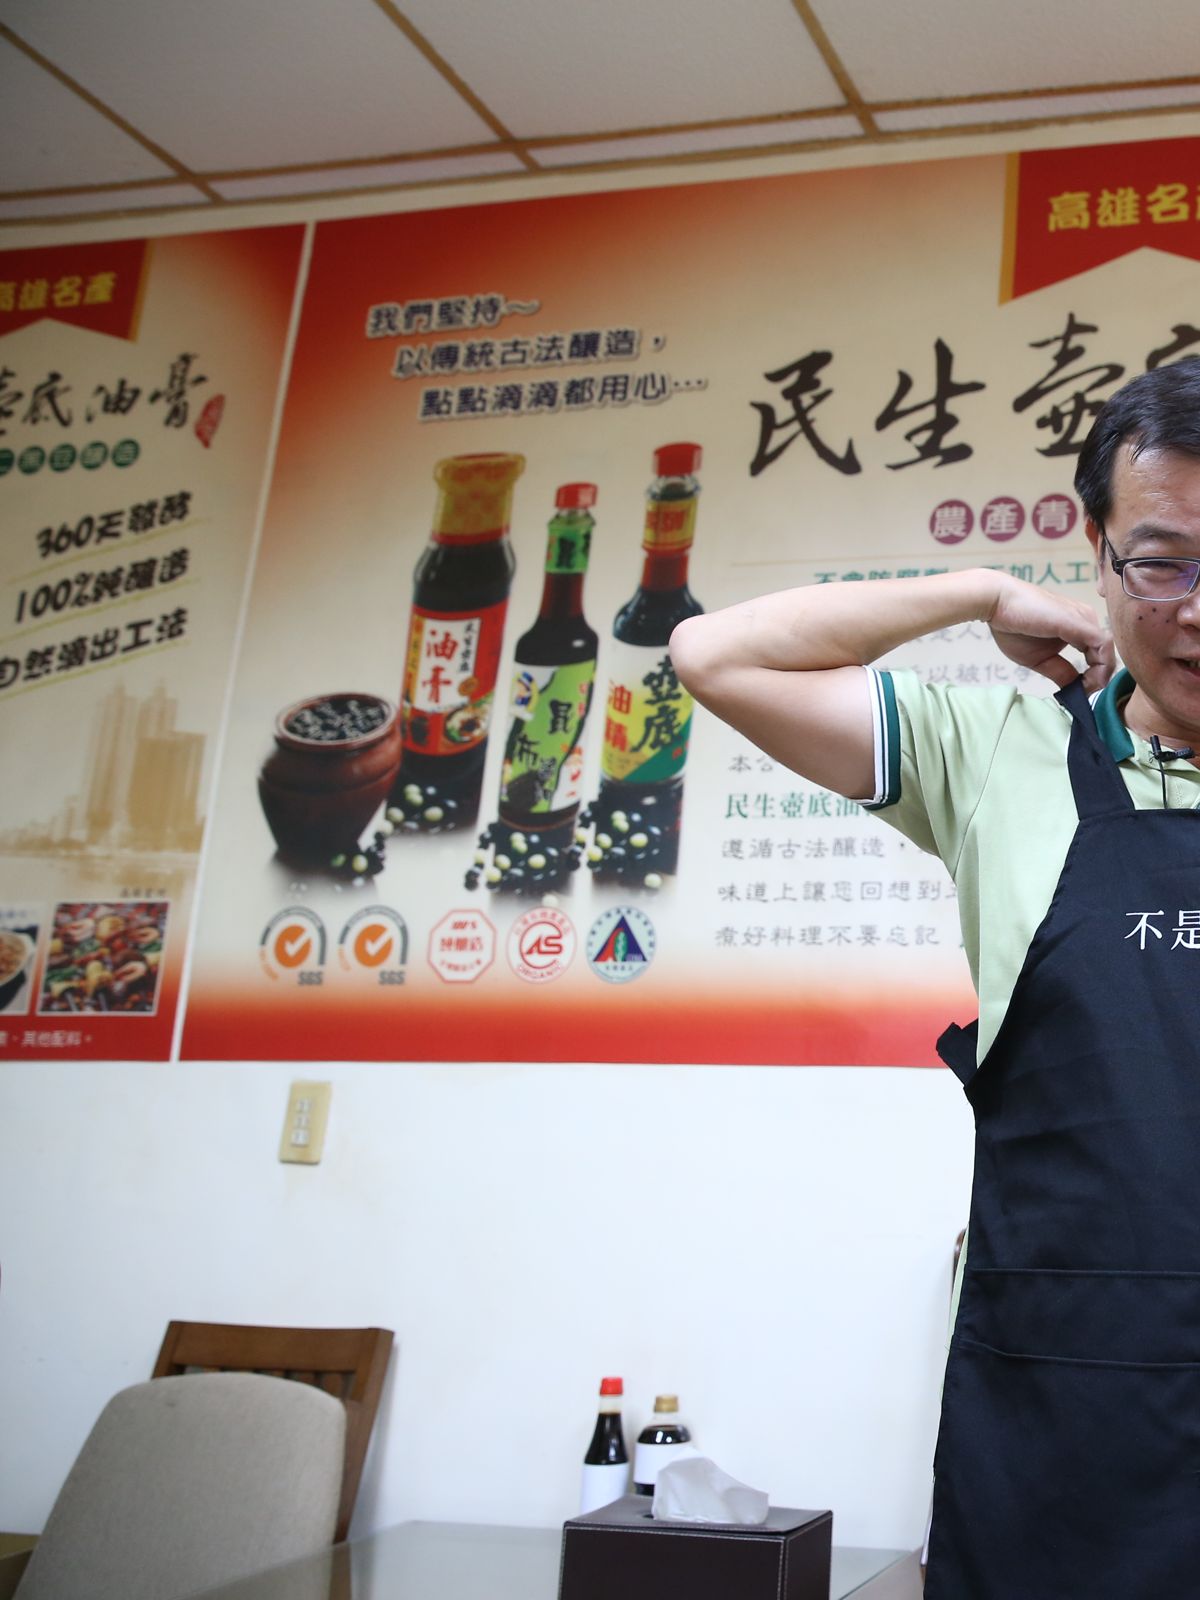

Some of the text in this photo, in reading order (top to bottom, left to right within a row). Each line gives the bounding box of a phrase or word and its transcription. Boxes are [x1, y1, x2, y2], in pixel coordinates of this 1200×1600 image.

[724, 792, 872, 819] 民生壺底油
